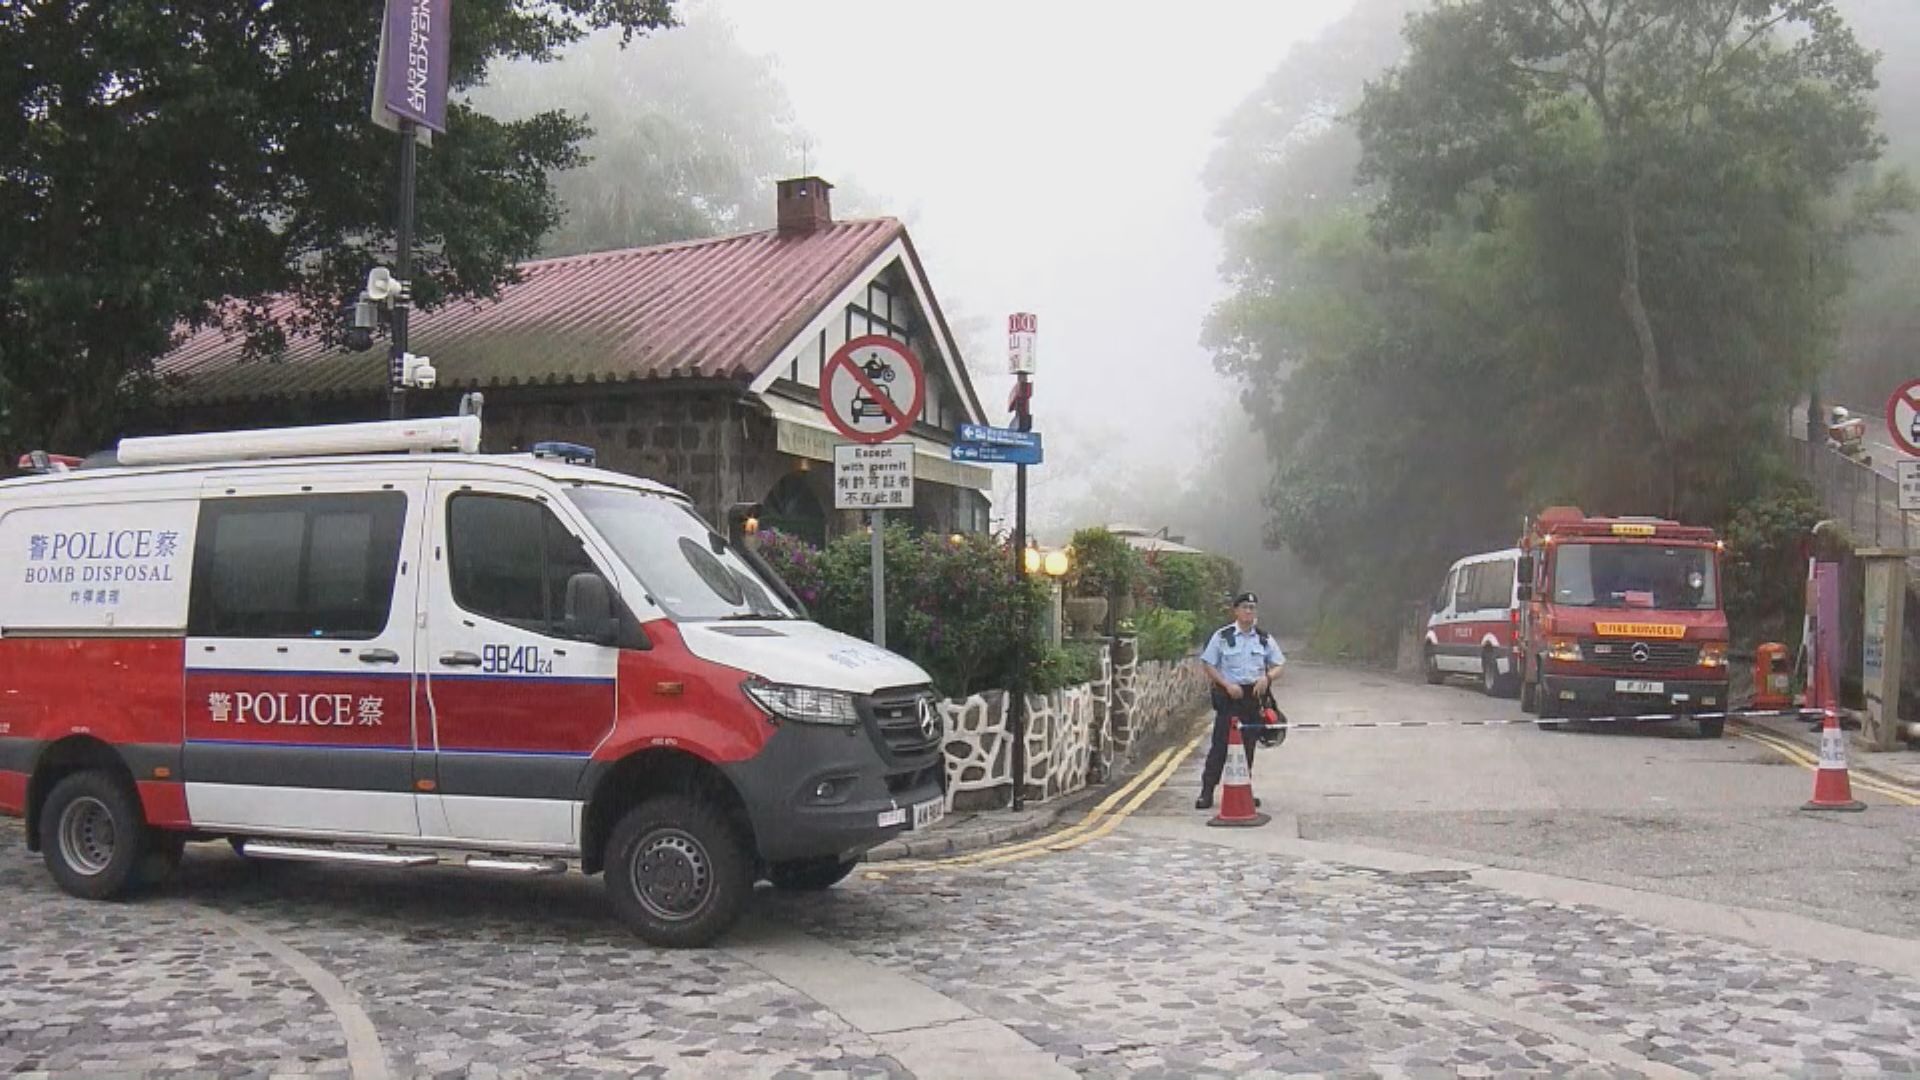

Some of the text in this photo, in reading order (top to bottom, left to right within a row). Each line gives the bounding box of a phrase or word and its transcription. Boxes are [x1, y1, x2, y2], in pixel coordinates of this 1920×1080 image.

[407, 68, 417, 108] CITY
[414, 34, 430, 114] KONG
[51, 530, 152, 560] POLICE
[25, 564, 172, 583] BOMB DISPOSAL
[483, 644, 538, 673] 9840
[235, 692, 354, 726] POLICE
